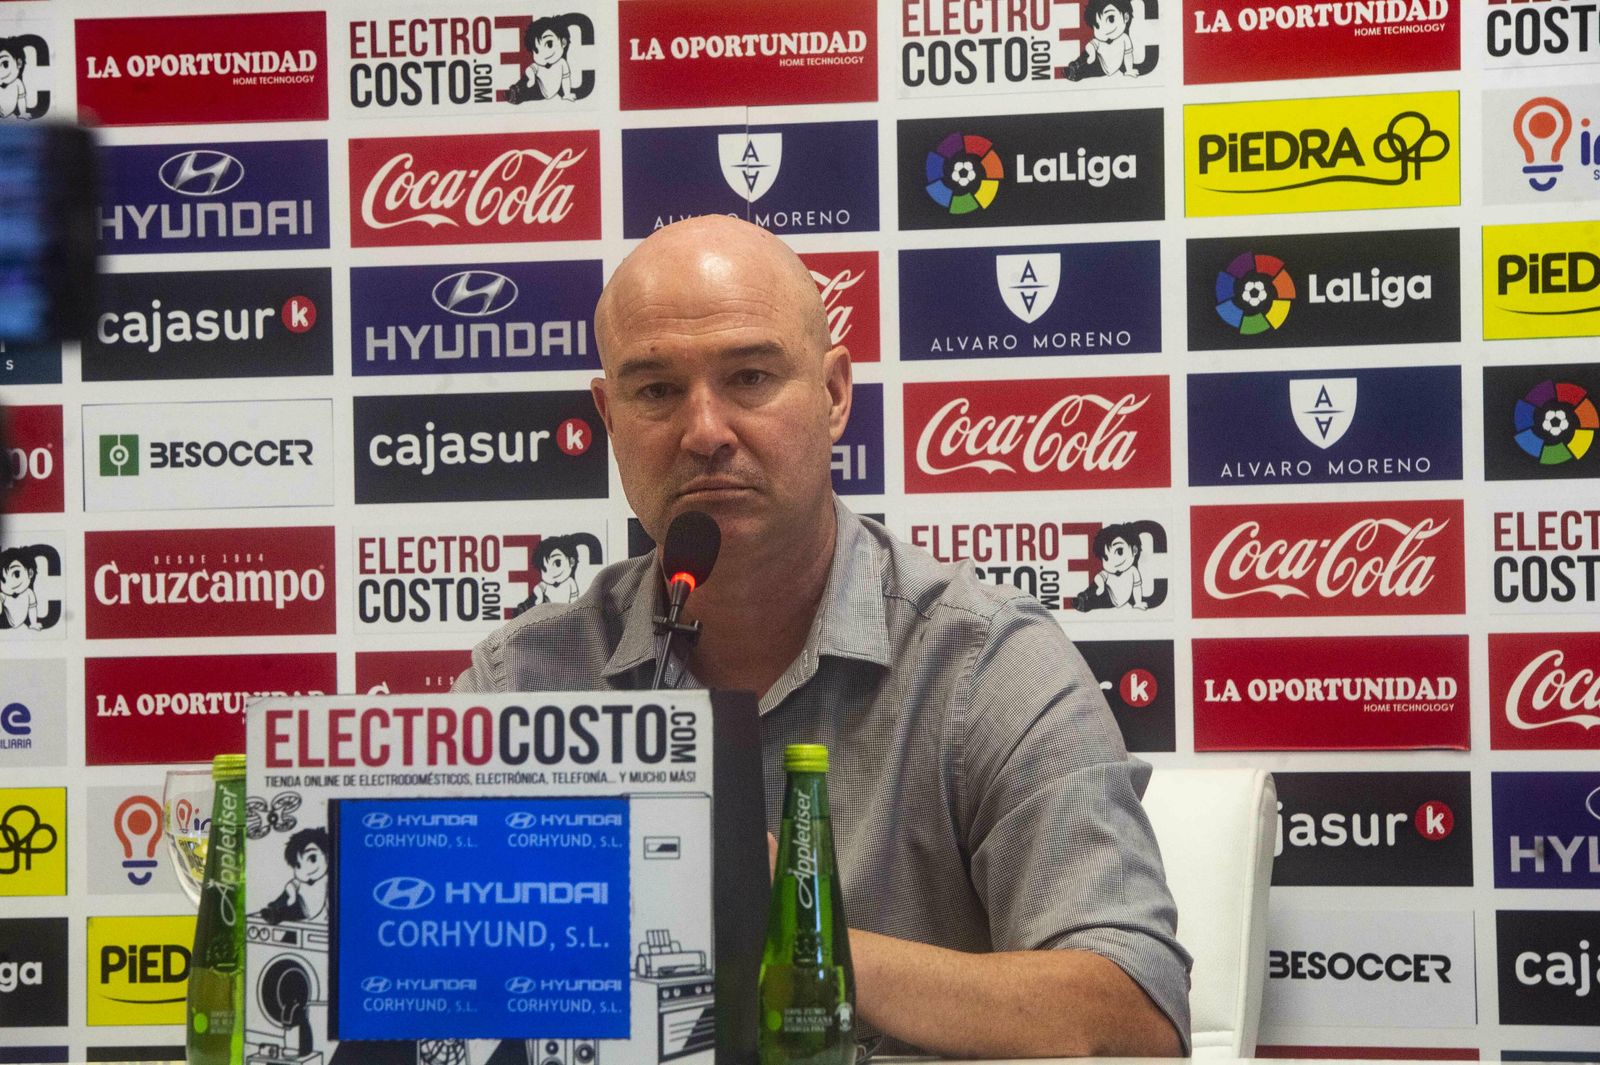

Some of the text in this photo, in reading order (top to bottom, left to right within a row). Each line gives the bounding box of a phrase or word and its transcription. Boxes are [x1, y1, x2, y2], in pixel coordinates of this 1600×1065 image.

[1194, 0, 1449, 33] LA OPORTUNIDAD
[1354, 23, 1446, 37] HOME TECHNOLOGY
[1487, 4, 1600, 57] COST
[349, 16, 492, 59] ELECTRO
[629, 30, 867, 60] LA OPORTUNIDAD
[86, 50, 317, 79] LA OPORTUNIDAD
[779, 56, 865, 67] HOME TECHNOLOGY
[902, 37, 1028, 87] COSTO
[232, 75, 315, 86] HOME TECHNOLOGY
[349, 60, 472, 108] COSTO
[1016, 147, 1137, 188] LaLiga
[361, 147, 589, 230] Coca-Cola
[98, 199, 312, 240] HYUNDAI
[755, 209, 850, 228] MORENO
[1308, 267, 1432, 308] LaLiga
[98, 299, 275, 352] cajasur
[366, 320, 587, 361] HYUNDAI
[931, 330, 1132, 352] ALVARO MORENO
[369, 421, 550, 475] cajasur
[916, 393, 1152, 475] Coca-Cola
[150, 439, 314, 468] BESOCCER
[1220, 457, 1432, 478] ALVARO MORENO
[358, 535, 500, 575] ELECTRO
[912, 522, 1059, 563] ELECTRO
[1203, 517, 1450, 600] Coca-Cola
[94, 561, 325, 609] Cruzcampo
[358, 577, 479, 623] COSTO
[1204, 676, 1457, 702] LA OPORTUNIDAD
[96, 695, 131, 717] LA
[1363, 702, 1454, 713] HOME TECHNOLOGY
[265, 775, 300, 787] TIENDA
[304, 775, 340, 787] ONLINE
[343, 774, 357, 786] DE
[619, 771, 626, 784] Y
[629, 771, 666, 783] MUCHO
[397, 814, 478, 827] HYUNDAI
[541, 813, 622, 827] HYUNDAI
[445, 881, 608, 905] HYUNDAI
[378, 920, 610, 951] CORHYUND, S.L.
[1269, 950, 1452, 984] BESOCCER
[1515, 939, 1600, 997] caj
[396, 978, 477, 991] HYUNDAI
[540, 978, 622, 991] HYUNDAI
